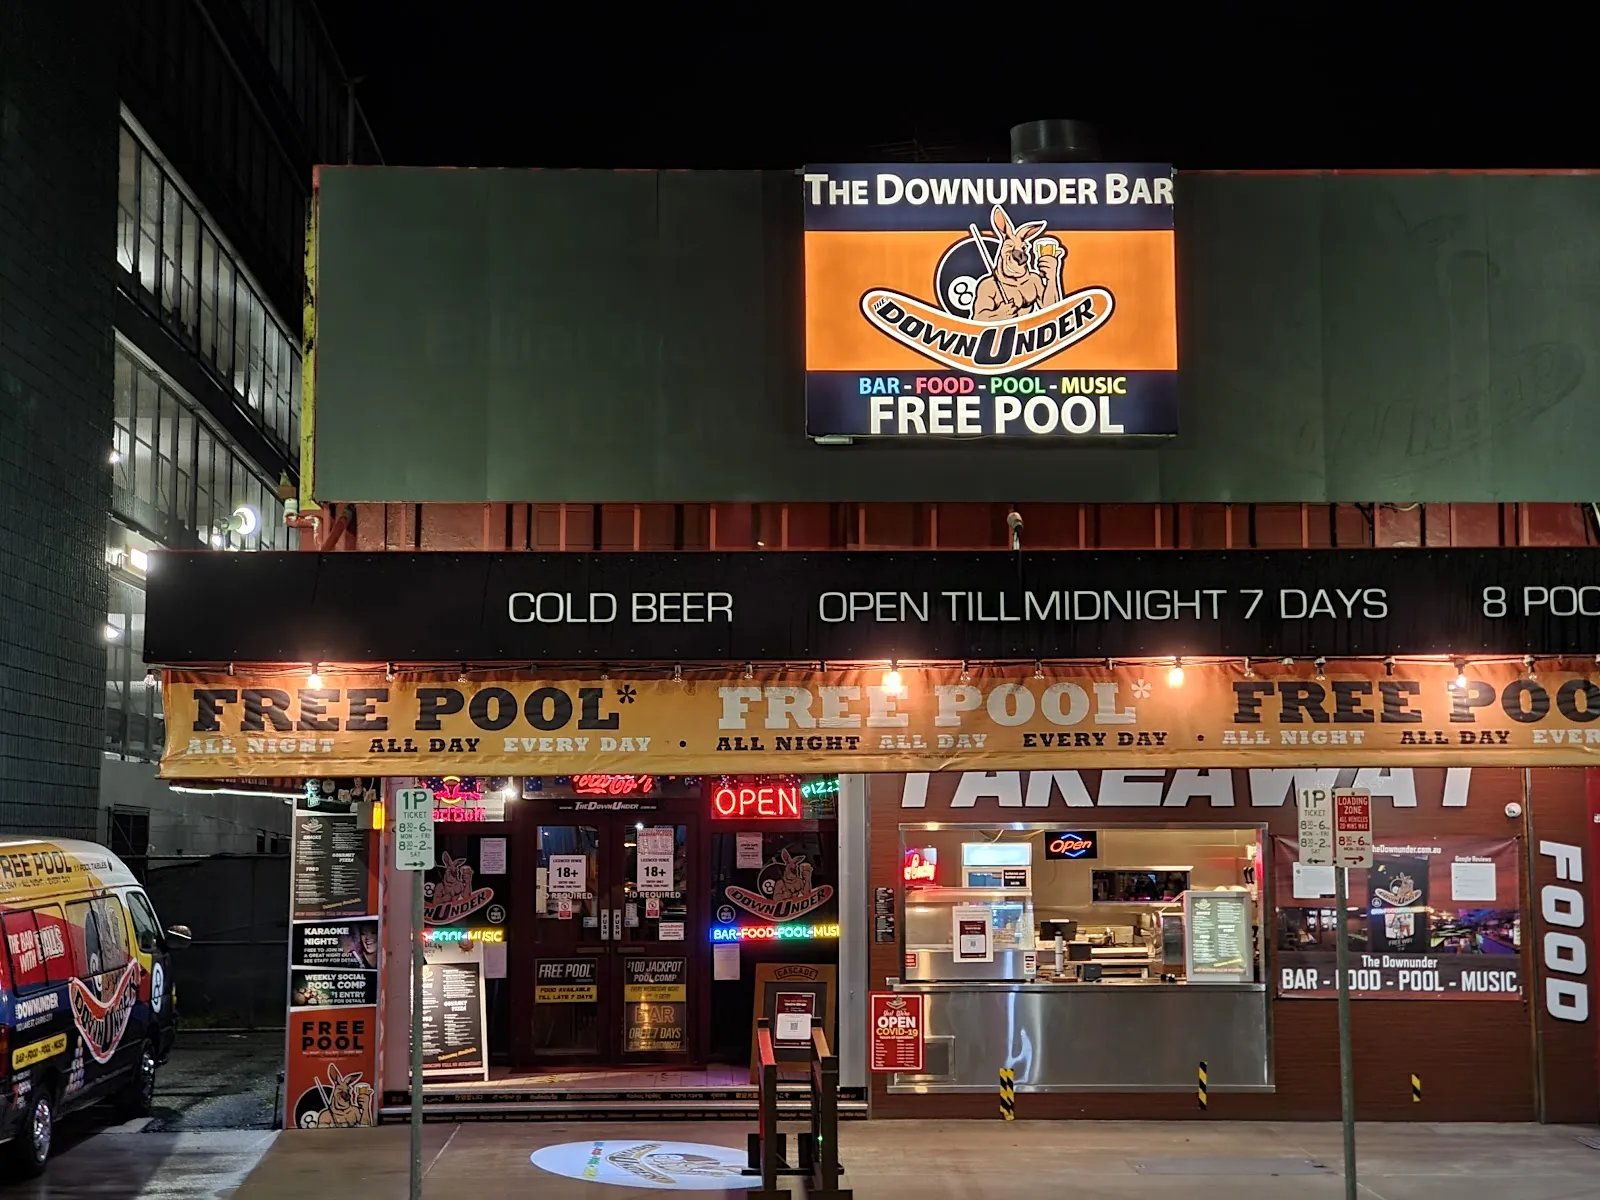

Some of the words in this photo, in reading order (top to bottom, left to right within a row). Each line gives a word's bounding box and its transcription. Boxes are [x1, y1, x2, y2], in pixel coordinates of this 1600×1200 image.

[804, 174, 869, 205] THE
[876, 174, 1098, 205] DOWNUNDER
[1105, 174, 1174, 205] BAR
[860, 377, 900, 395] BAR
[916, 377, 974, 395] FOOD
[990, 377, 1046, 395] POOL
[1061, 377, 1127, 395] MUSIC
[870, 397, 981, 434] FREE
[995, 397, 1124, 434] POOL
[508, 592, 616, 622] COLD
[632, 592, 733, 622] BEER
[819, 591, 928, 622] OPEN
[1240, 589, 1264, 620] 7
[1280, 588, 1388, 619] DAYS
[1483, 586, 1507, 618] 8
[193, 688, 389, 732] FREE
[718, 686, 908, 730] FREE
[1232, 681, 1422, 724] FREE
[186, 738, 236, 754] ALL
[248, 738, 334, 754] NIGHT
[368, 738, 418, 753] ALL
[429, 738, 480, 753] DAY
[504, 737, 590, 752] EVERY
[600, 737, 652, 752] DAY
[716, 737, 764, 752] ALL
[776, 736, 860, 750] NIGHT
[878, 734, 928, 749] ALL
[937, 734, 988, 748] DAY
[1023, 732, 1106, 748] EVERY
[1118, 732, 1168, 746] DAY
[1222, 730, 1270, 744] ALL
[1280, 730, 1365, 744] NIGHT
[1400, 730, 1449, 744] ALL
[1460, 730, 1510, 744] DAY
[402, 791, 428, 810] 1P
[716, 788, 798, 816] OPEN
[1303, 790, 1326, 808] 1P
[1338, 797, 1368, 805] LOADING
[1344, 806, 1363, 814] ZONE
[1050, 840, 1092, 853] Open
[1372, 845, 1442, 854] heDownunder.com.au
[32, 851, 72, 876] POOL
[644, 866, 666, 877] 18+
[556, 867, 578, 878] 18+
[552, 892, 593, 900] REQUIRED
[424, 891, 486, 920] NUNDER
[1540, 840, 1588, 1022] FOOD
[8, 934, 20, 954] THE
[20, 930, 34, 952] BAR
[304, 938, 338, 946] NIGHTS
[19, 949, 37, 974] WITH
[627, 961, 645, 972] $100
[646, 961, 683, 972] JACKPOT
[1362, 955, 1379, 967] The
[1383, 956, 1438, 968] Downunder
[539, 964, 563, 978] FREE
[633, 974, 654, 982] POOL
[655, 974, 677, 982] COMP
[777, 968, 816, 977] CASCADE
[337, 981, 366, 989] COMP
[1282, 968, 1318, 990] BAR
[1399, 970, 1444, 991] POOL
[1461, 971, 1517, 992] MUSIC
[18, 992, 59, 1019] DOWNUNDER
[302, 1021, 364, 1036] FREE
[878, 1016, 916, 1028] OPEN
[660, 1028, 681, 1039] DAYS
[876, 1028, 918, 1036] COVID-19
[302, 1036, 364, 1050] POOL
